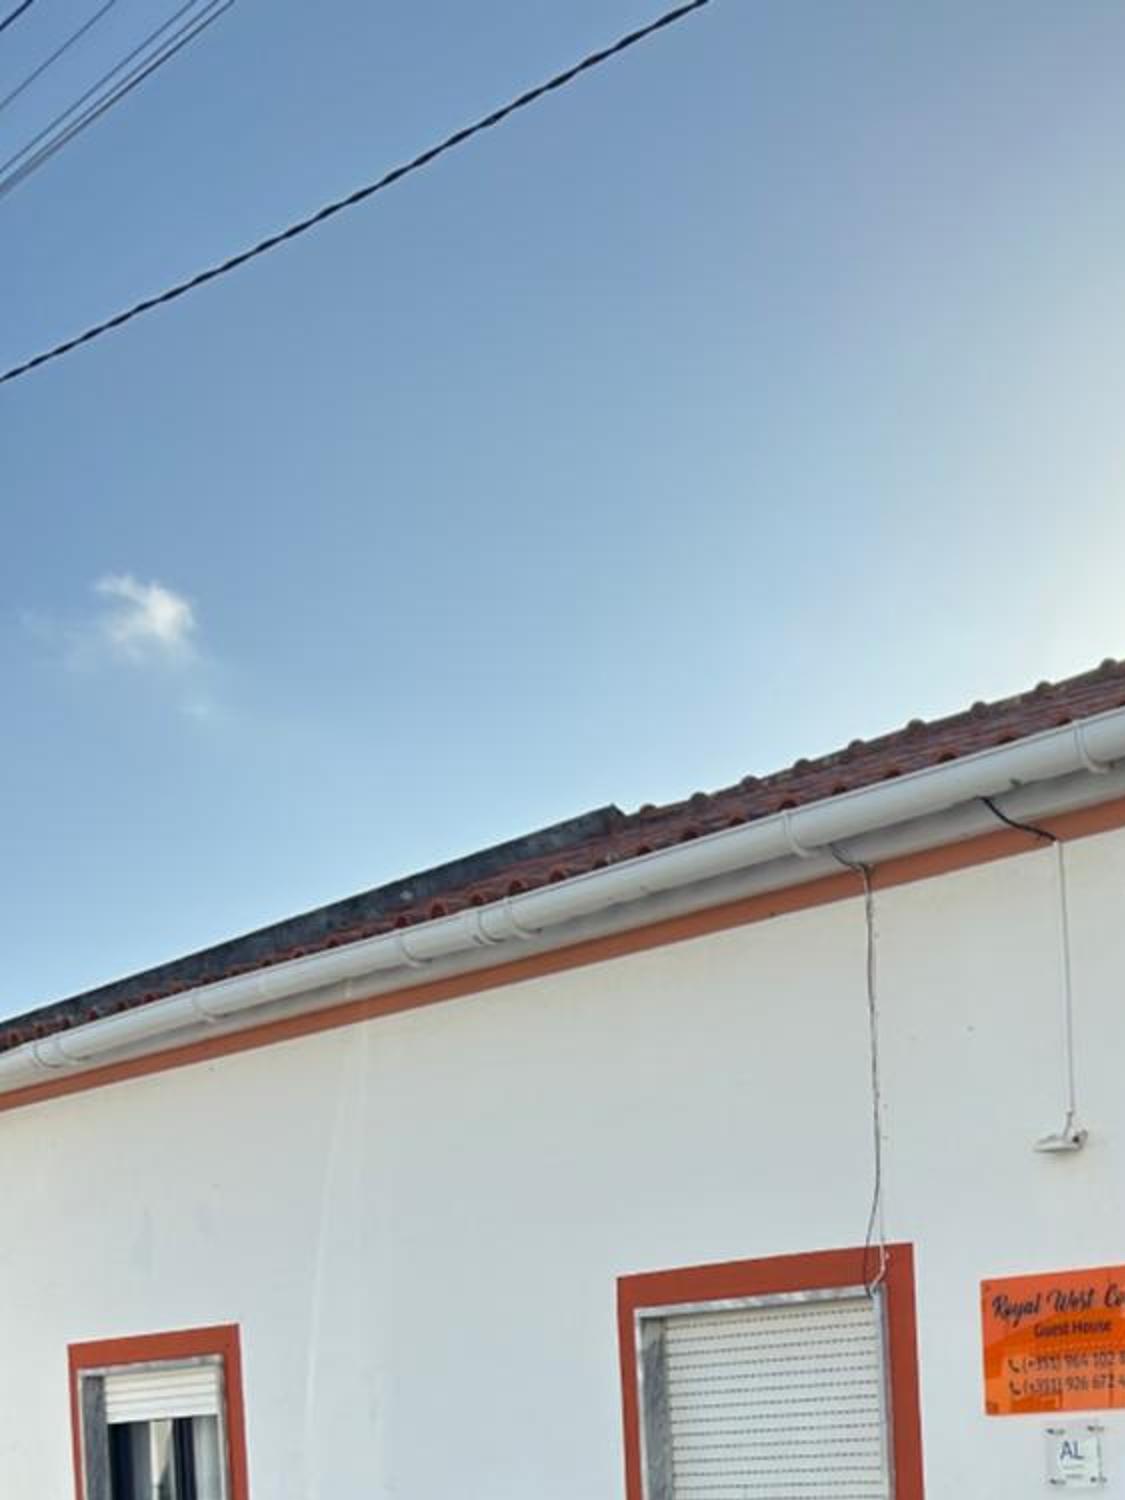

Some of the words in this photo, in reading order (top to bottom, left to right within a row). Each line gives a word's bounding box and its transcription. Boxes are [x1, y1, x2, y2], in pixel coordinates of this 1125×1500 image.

[992, 1294, 1041, 1328] Royal
[1047, 1288, 1095, 1312] West
[1072, 1320, 1112, 1334] House
[1060, 1440, 1084, 1460] AL
